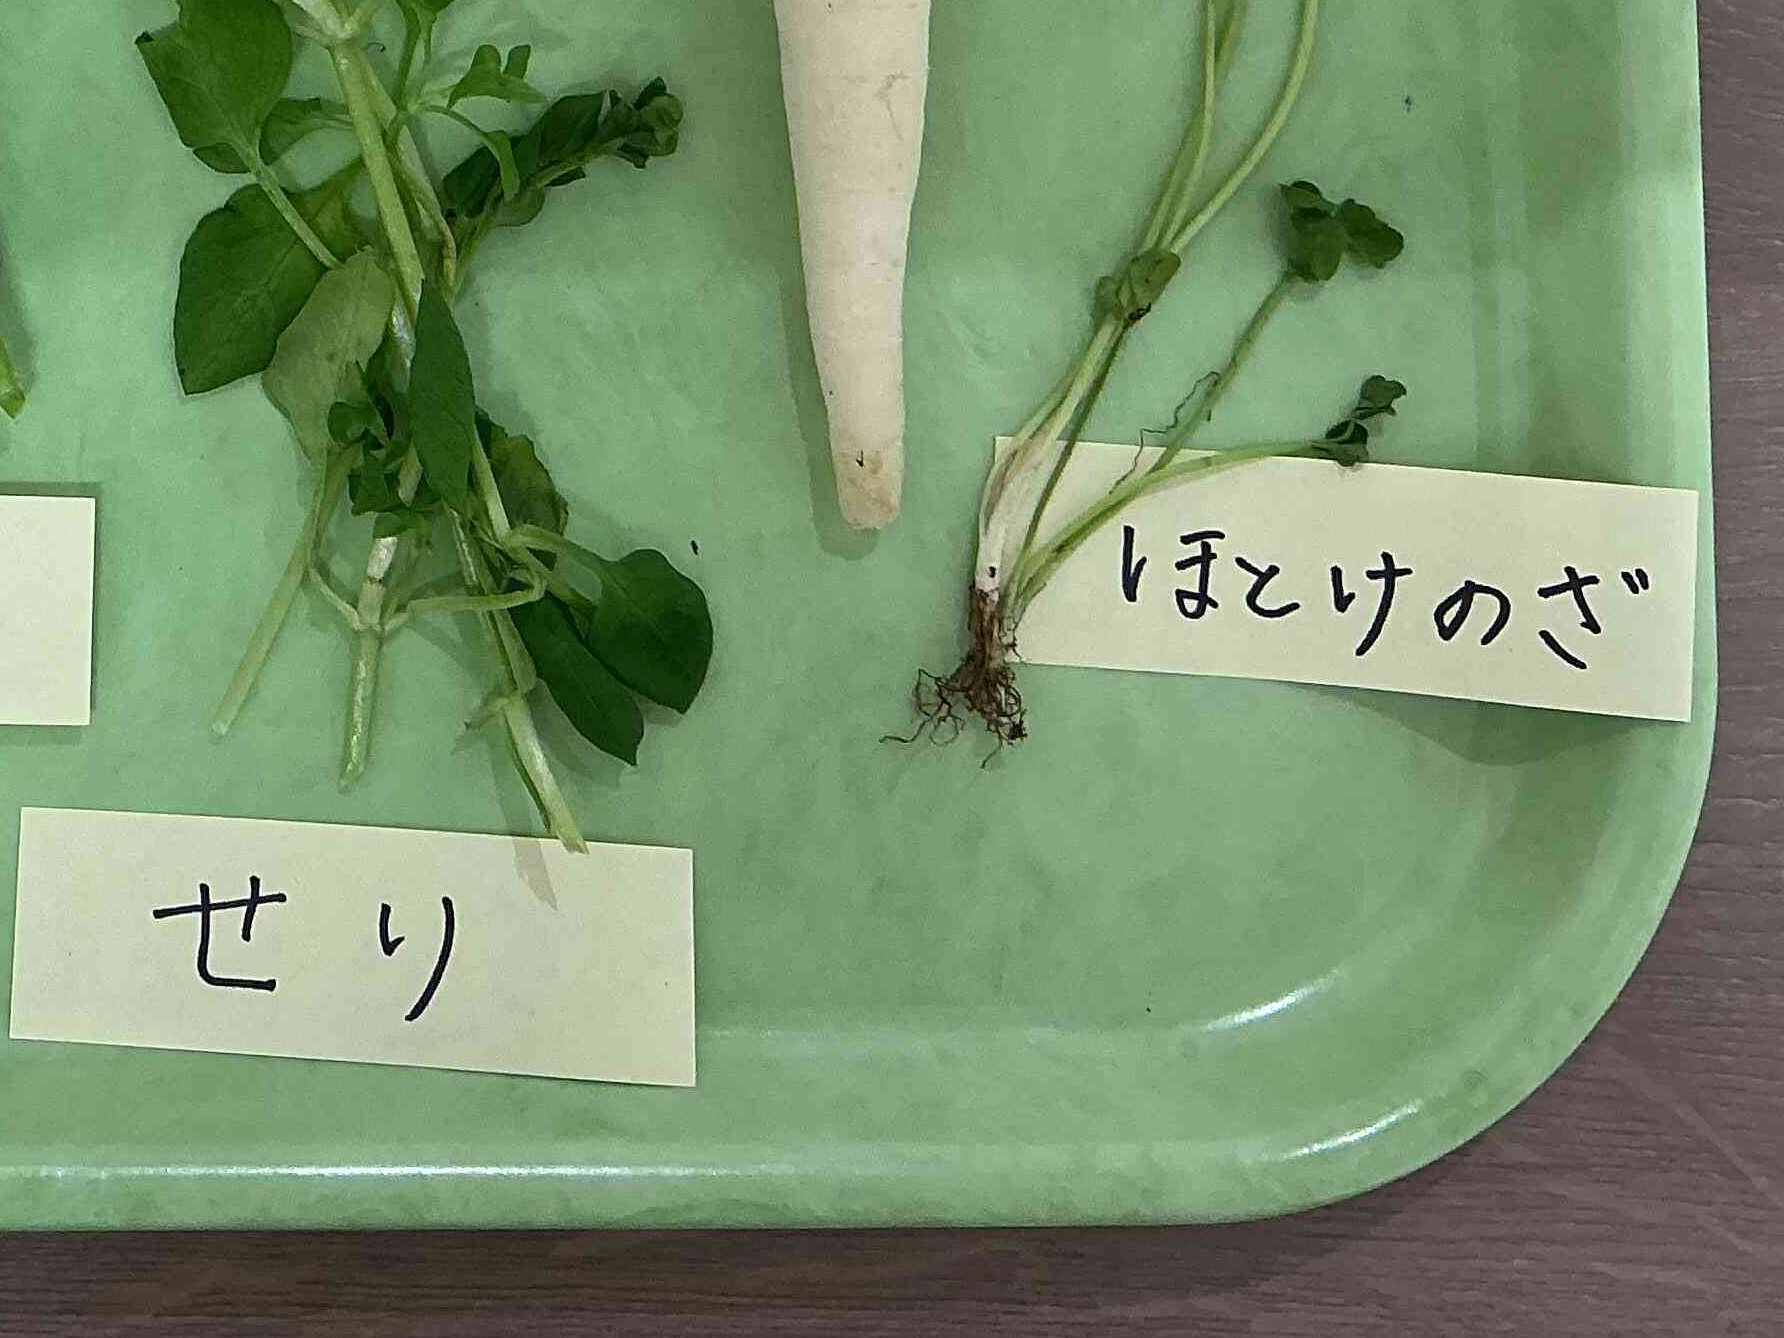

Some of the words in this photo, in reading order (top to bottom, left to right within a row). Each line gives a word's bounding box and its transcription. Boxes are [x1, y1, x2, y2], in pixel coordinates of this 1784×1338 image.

[1120, 524, 1652, 671] ほとけのざ
[151, 874, 457, 1024] せり
